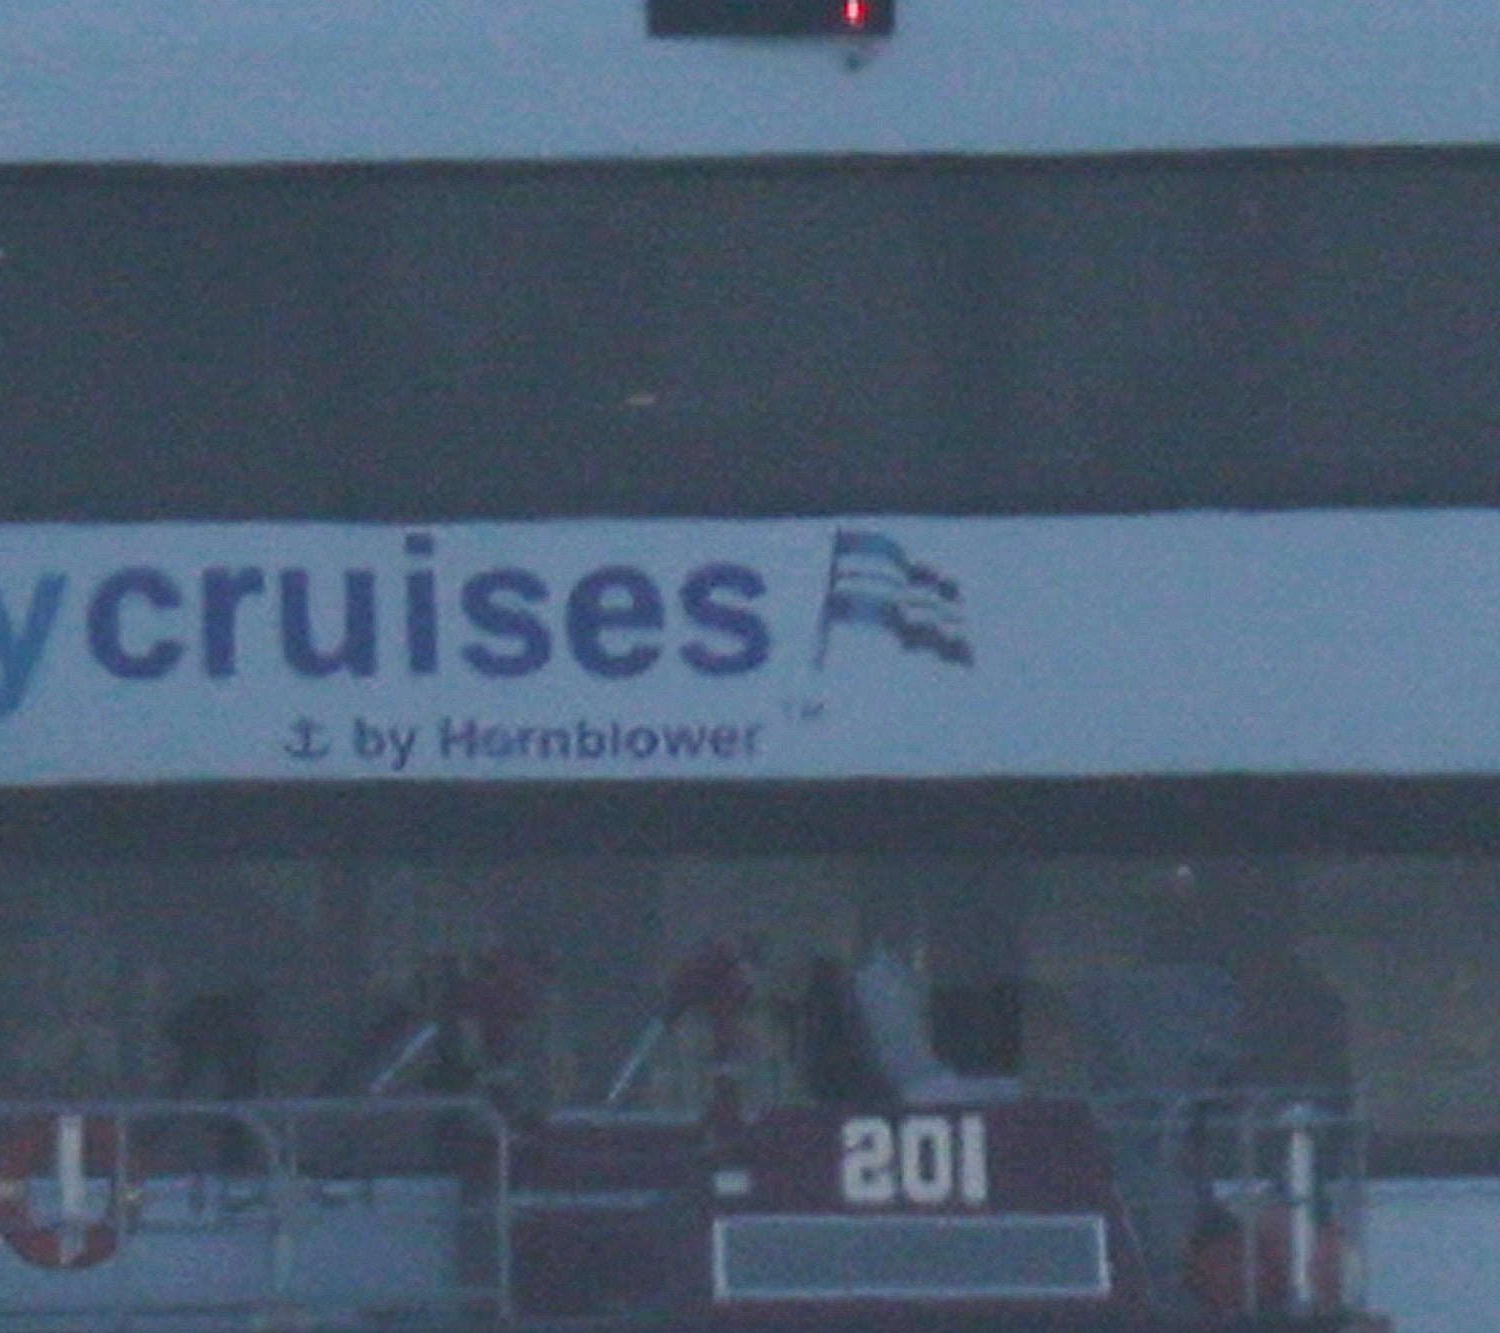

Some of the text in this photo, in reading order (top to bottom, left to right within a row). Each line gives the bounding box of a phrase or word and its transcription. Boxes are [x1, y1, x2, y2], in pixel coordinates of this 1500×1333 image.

[351, 714, 764, 772] by Hornblower
[841, 1113, 989, 1203] 201
